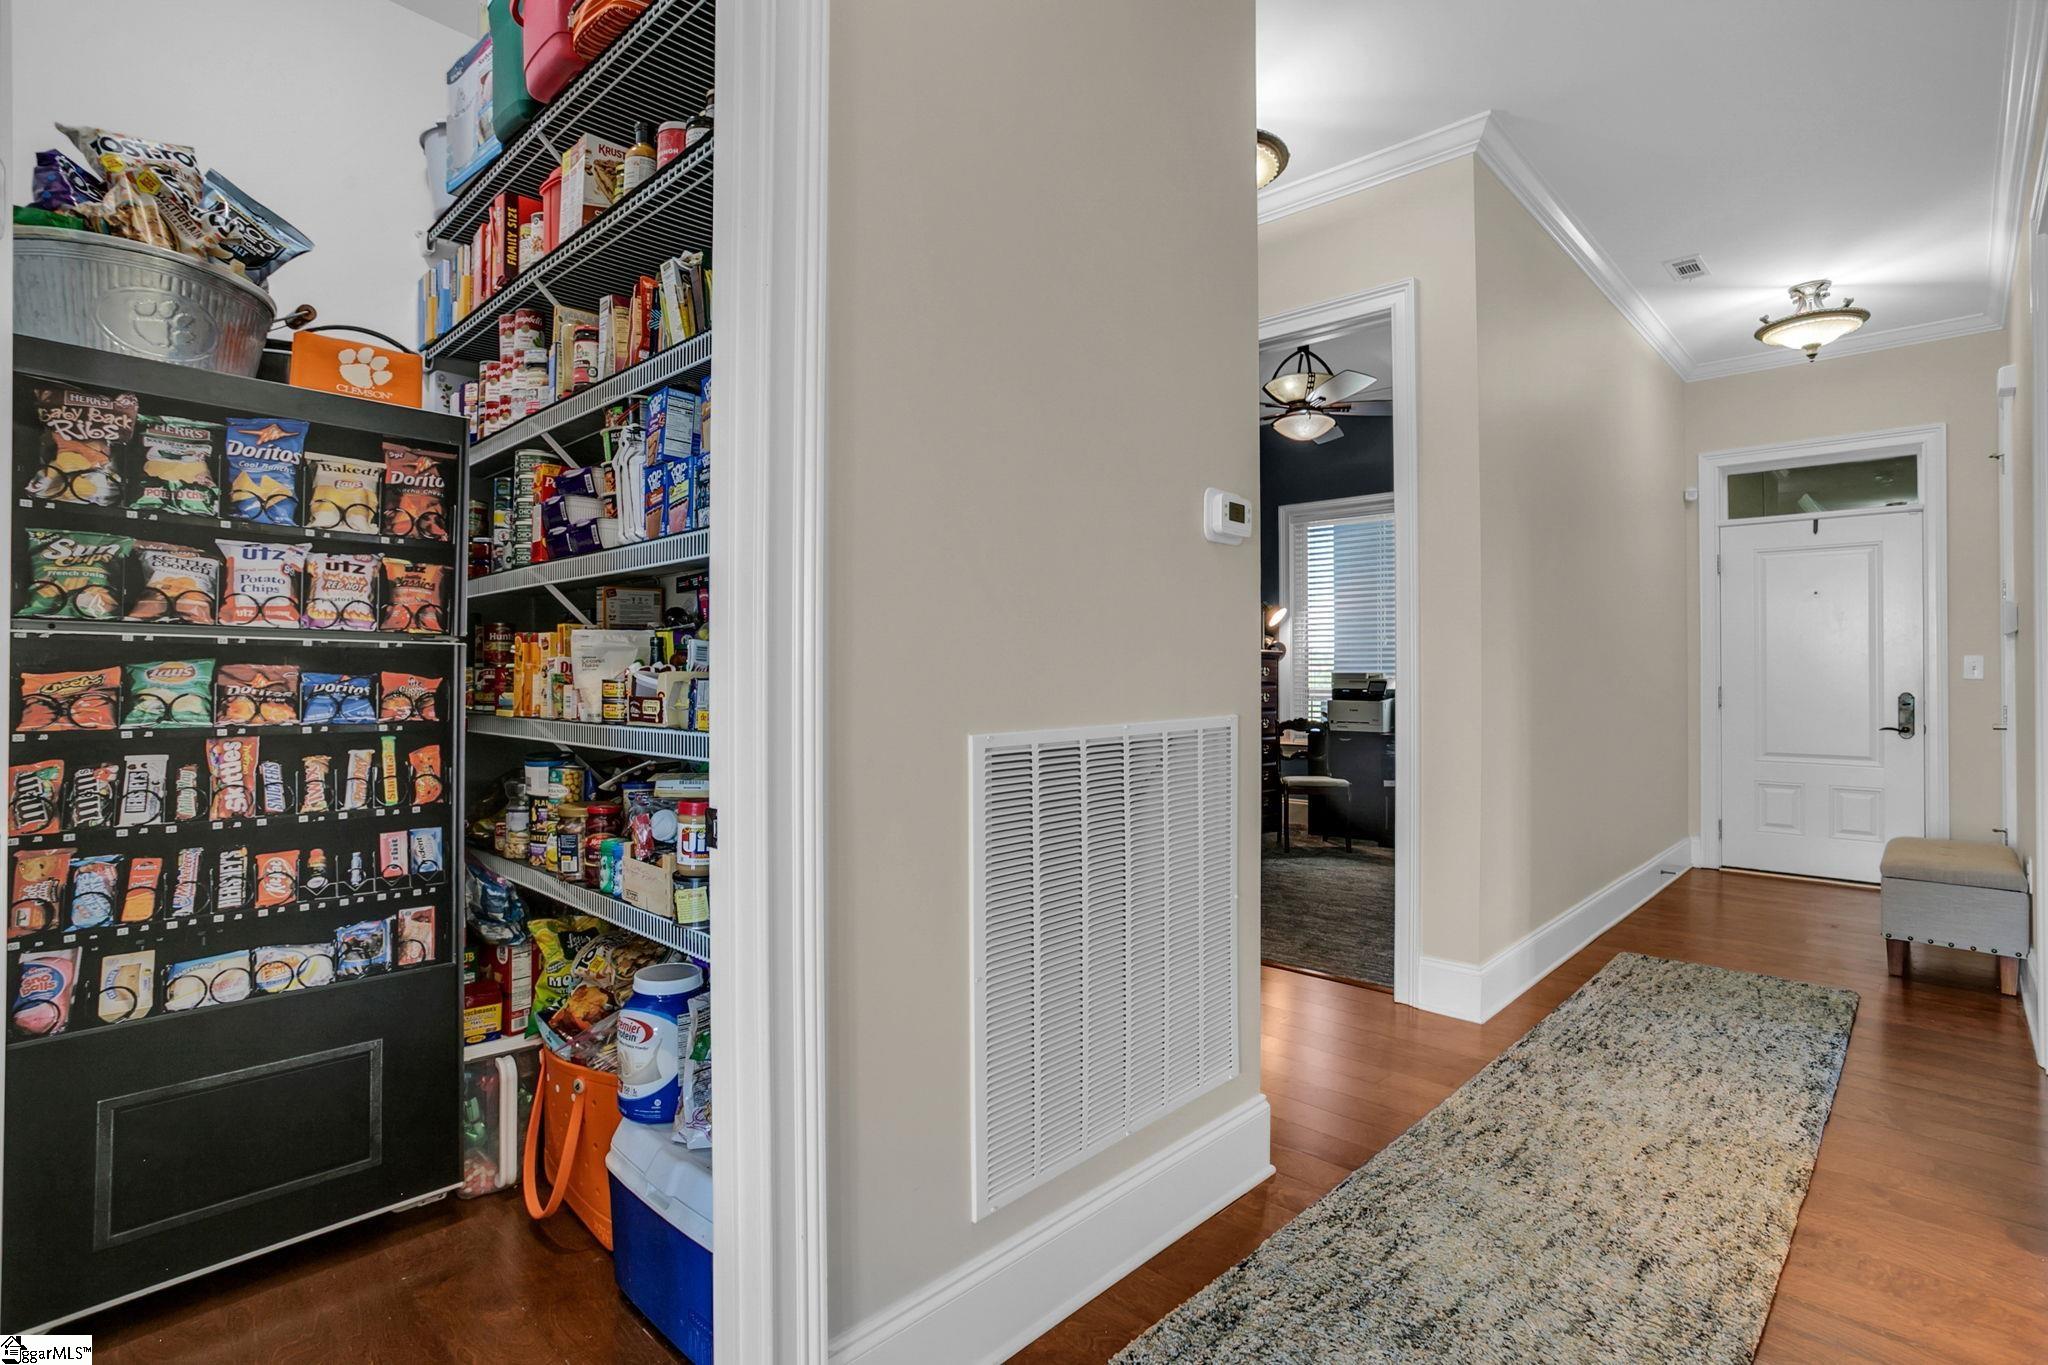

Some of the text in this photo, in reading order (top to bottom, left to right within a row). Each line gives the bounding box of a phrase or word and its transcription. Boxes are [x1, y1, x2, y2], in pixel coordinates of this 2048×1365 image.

[598, 143, 626, 160] KRUST
[507, 207, 518, 266] FAMILY SIZE
[336, 383, 391, 400] CLEMSON
[88, 407, 133, 430] Back
[48, 419, 121, 441] Ribs
[226, 439, 302, 465] Doritos
[43, 538, 120, 560] Sun
[240, 574, 286, 585] Potato
[325, 579, 364, 592] RED HOT
[240, 584, 280, 595] Chips
[262, 762, 285, 811] SNICKERS
[619, 1018, 641, 1034] emier
[619, 1030, 637, 1043] otein
